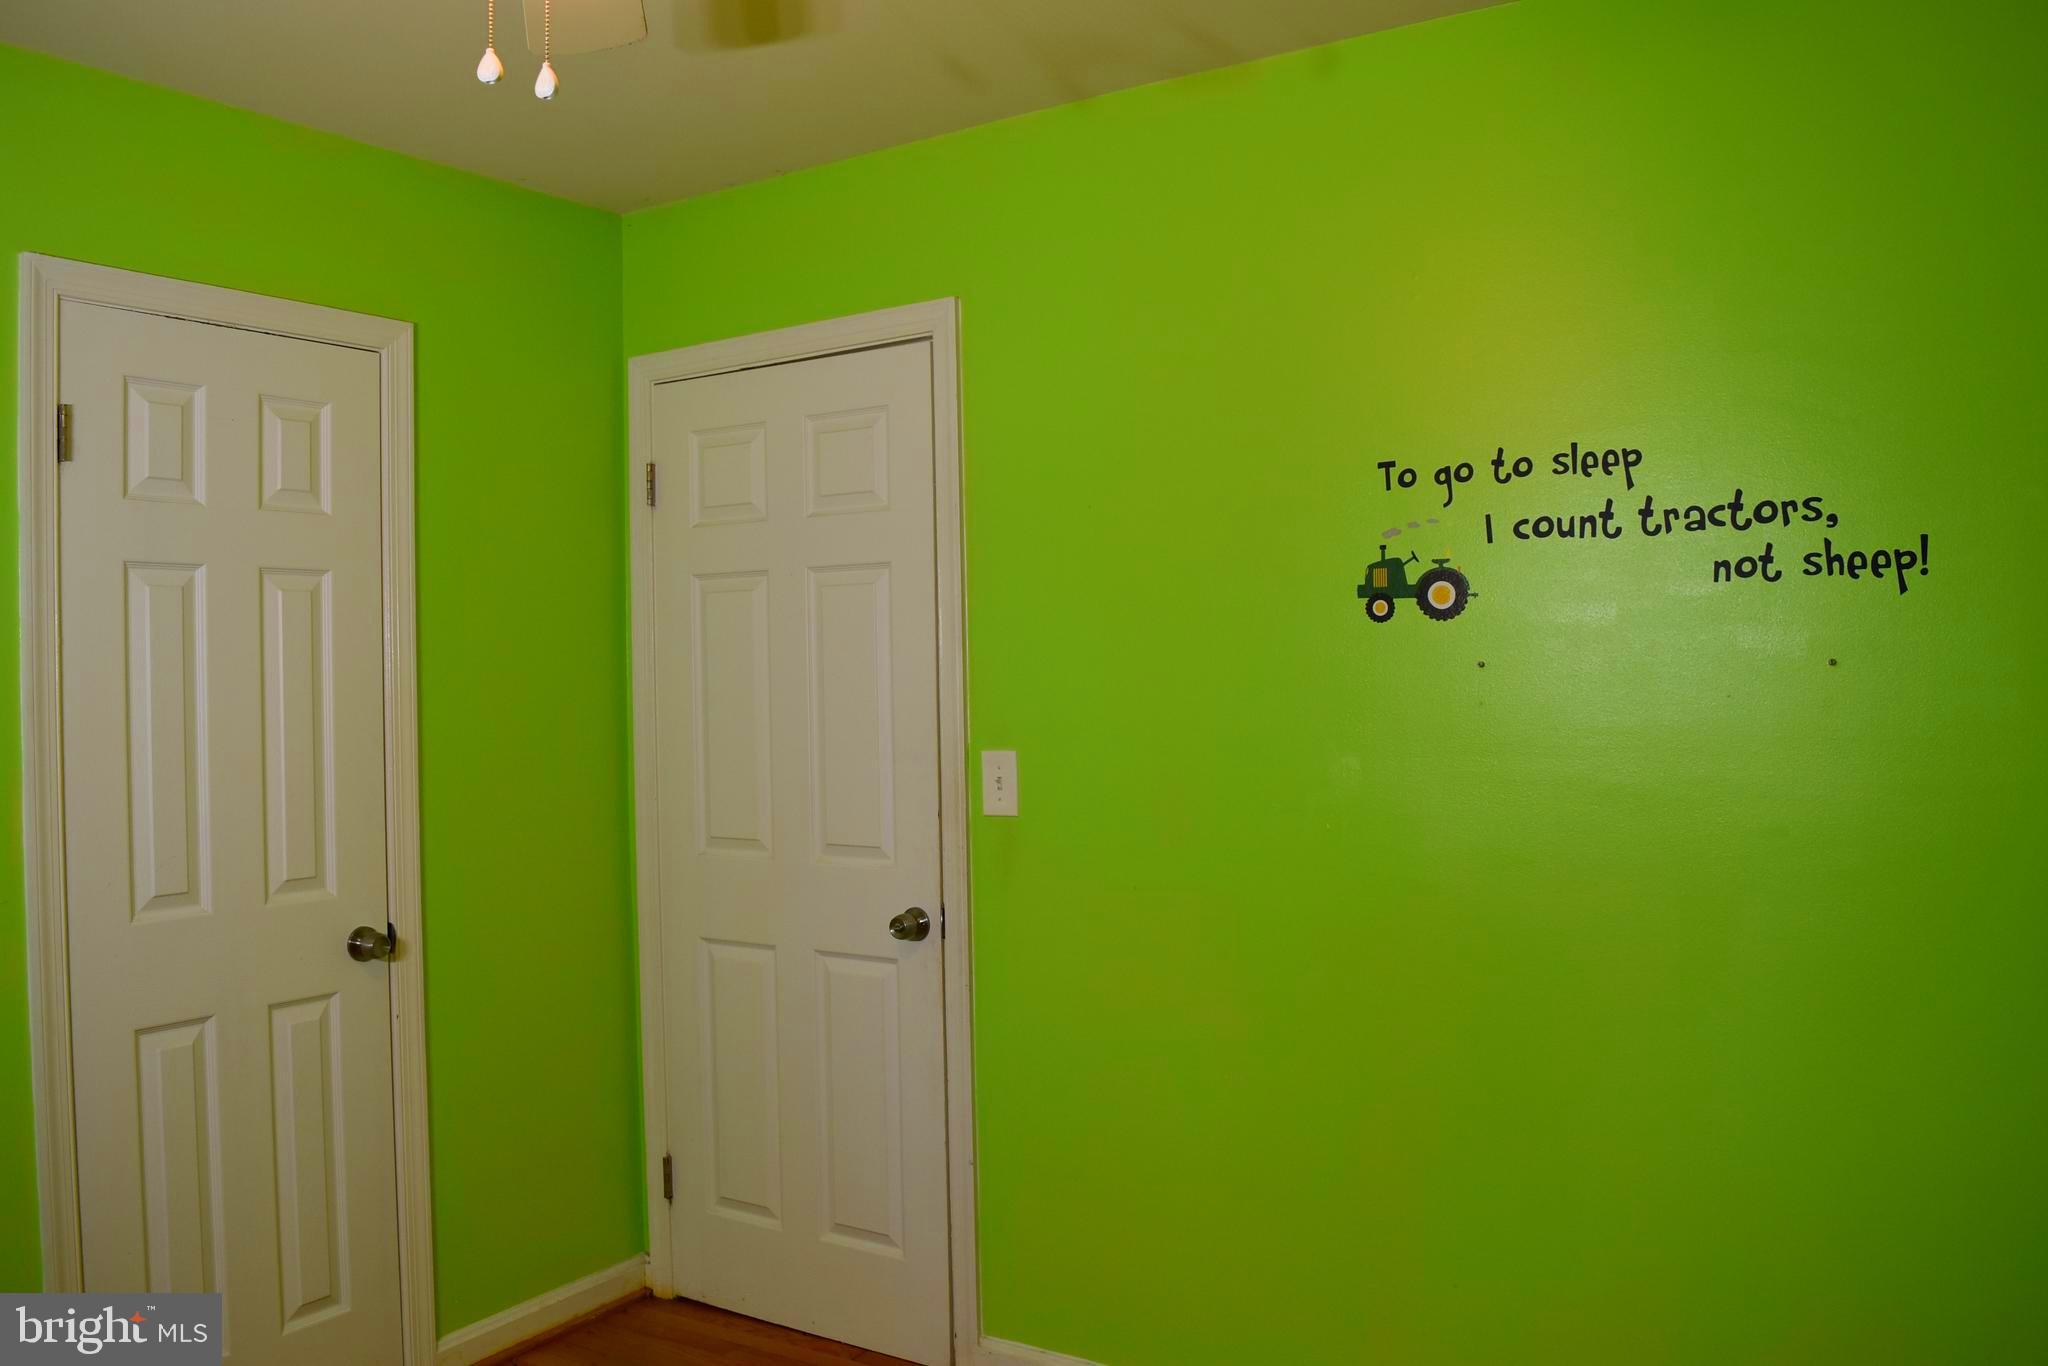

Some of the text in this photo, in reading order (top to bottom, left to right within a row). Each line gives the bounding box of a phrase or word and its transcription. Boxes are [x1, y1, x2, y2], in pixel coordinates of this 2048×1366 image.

[1377, 442, 1643, 508] To go to sleep
[1485, 488, 1839, 544] I count tractors,
[1713, 533, 1929, 596] not sheep!
